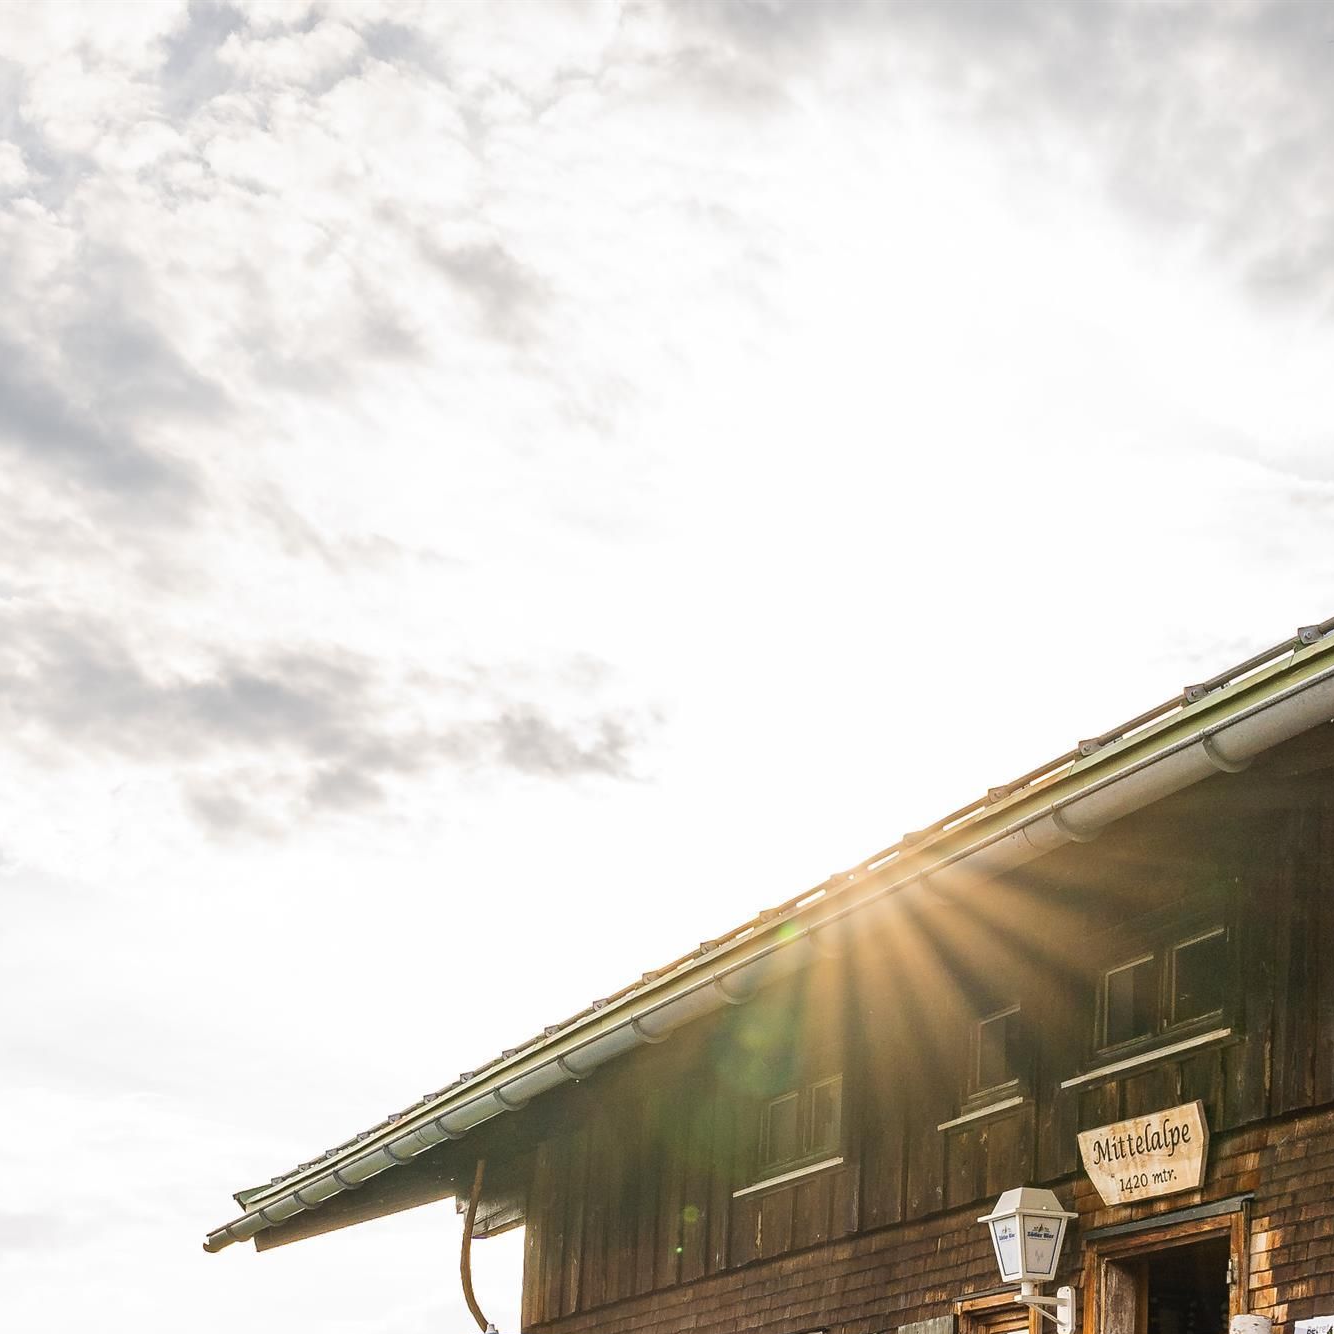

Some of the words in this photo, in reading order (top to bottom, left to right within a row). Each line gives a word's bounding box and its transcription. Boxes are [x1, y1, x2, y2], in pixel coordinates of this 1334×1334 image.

[1093, 1118, 1192, 1165] Mittelalpe
[1119, 1173, 1149, 1194] 1420
[1151, 1168, 1178, 1185] mtr.
